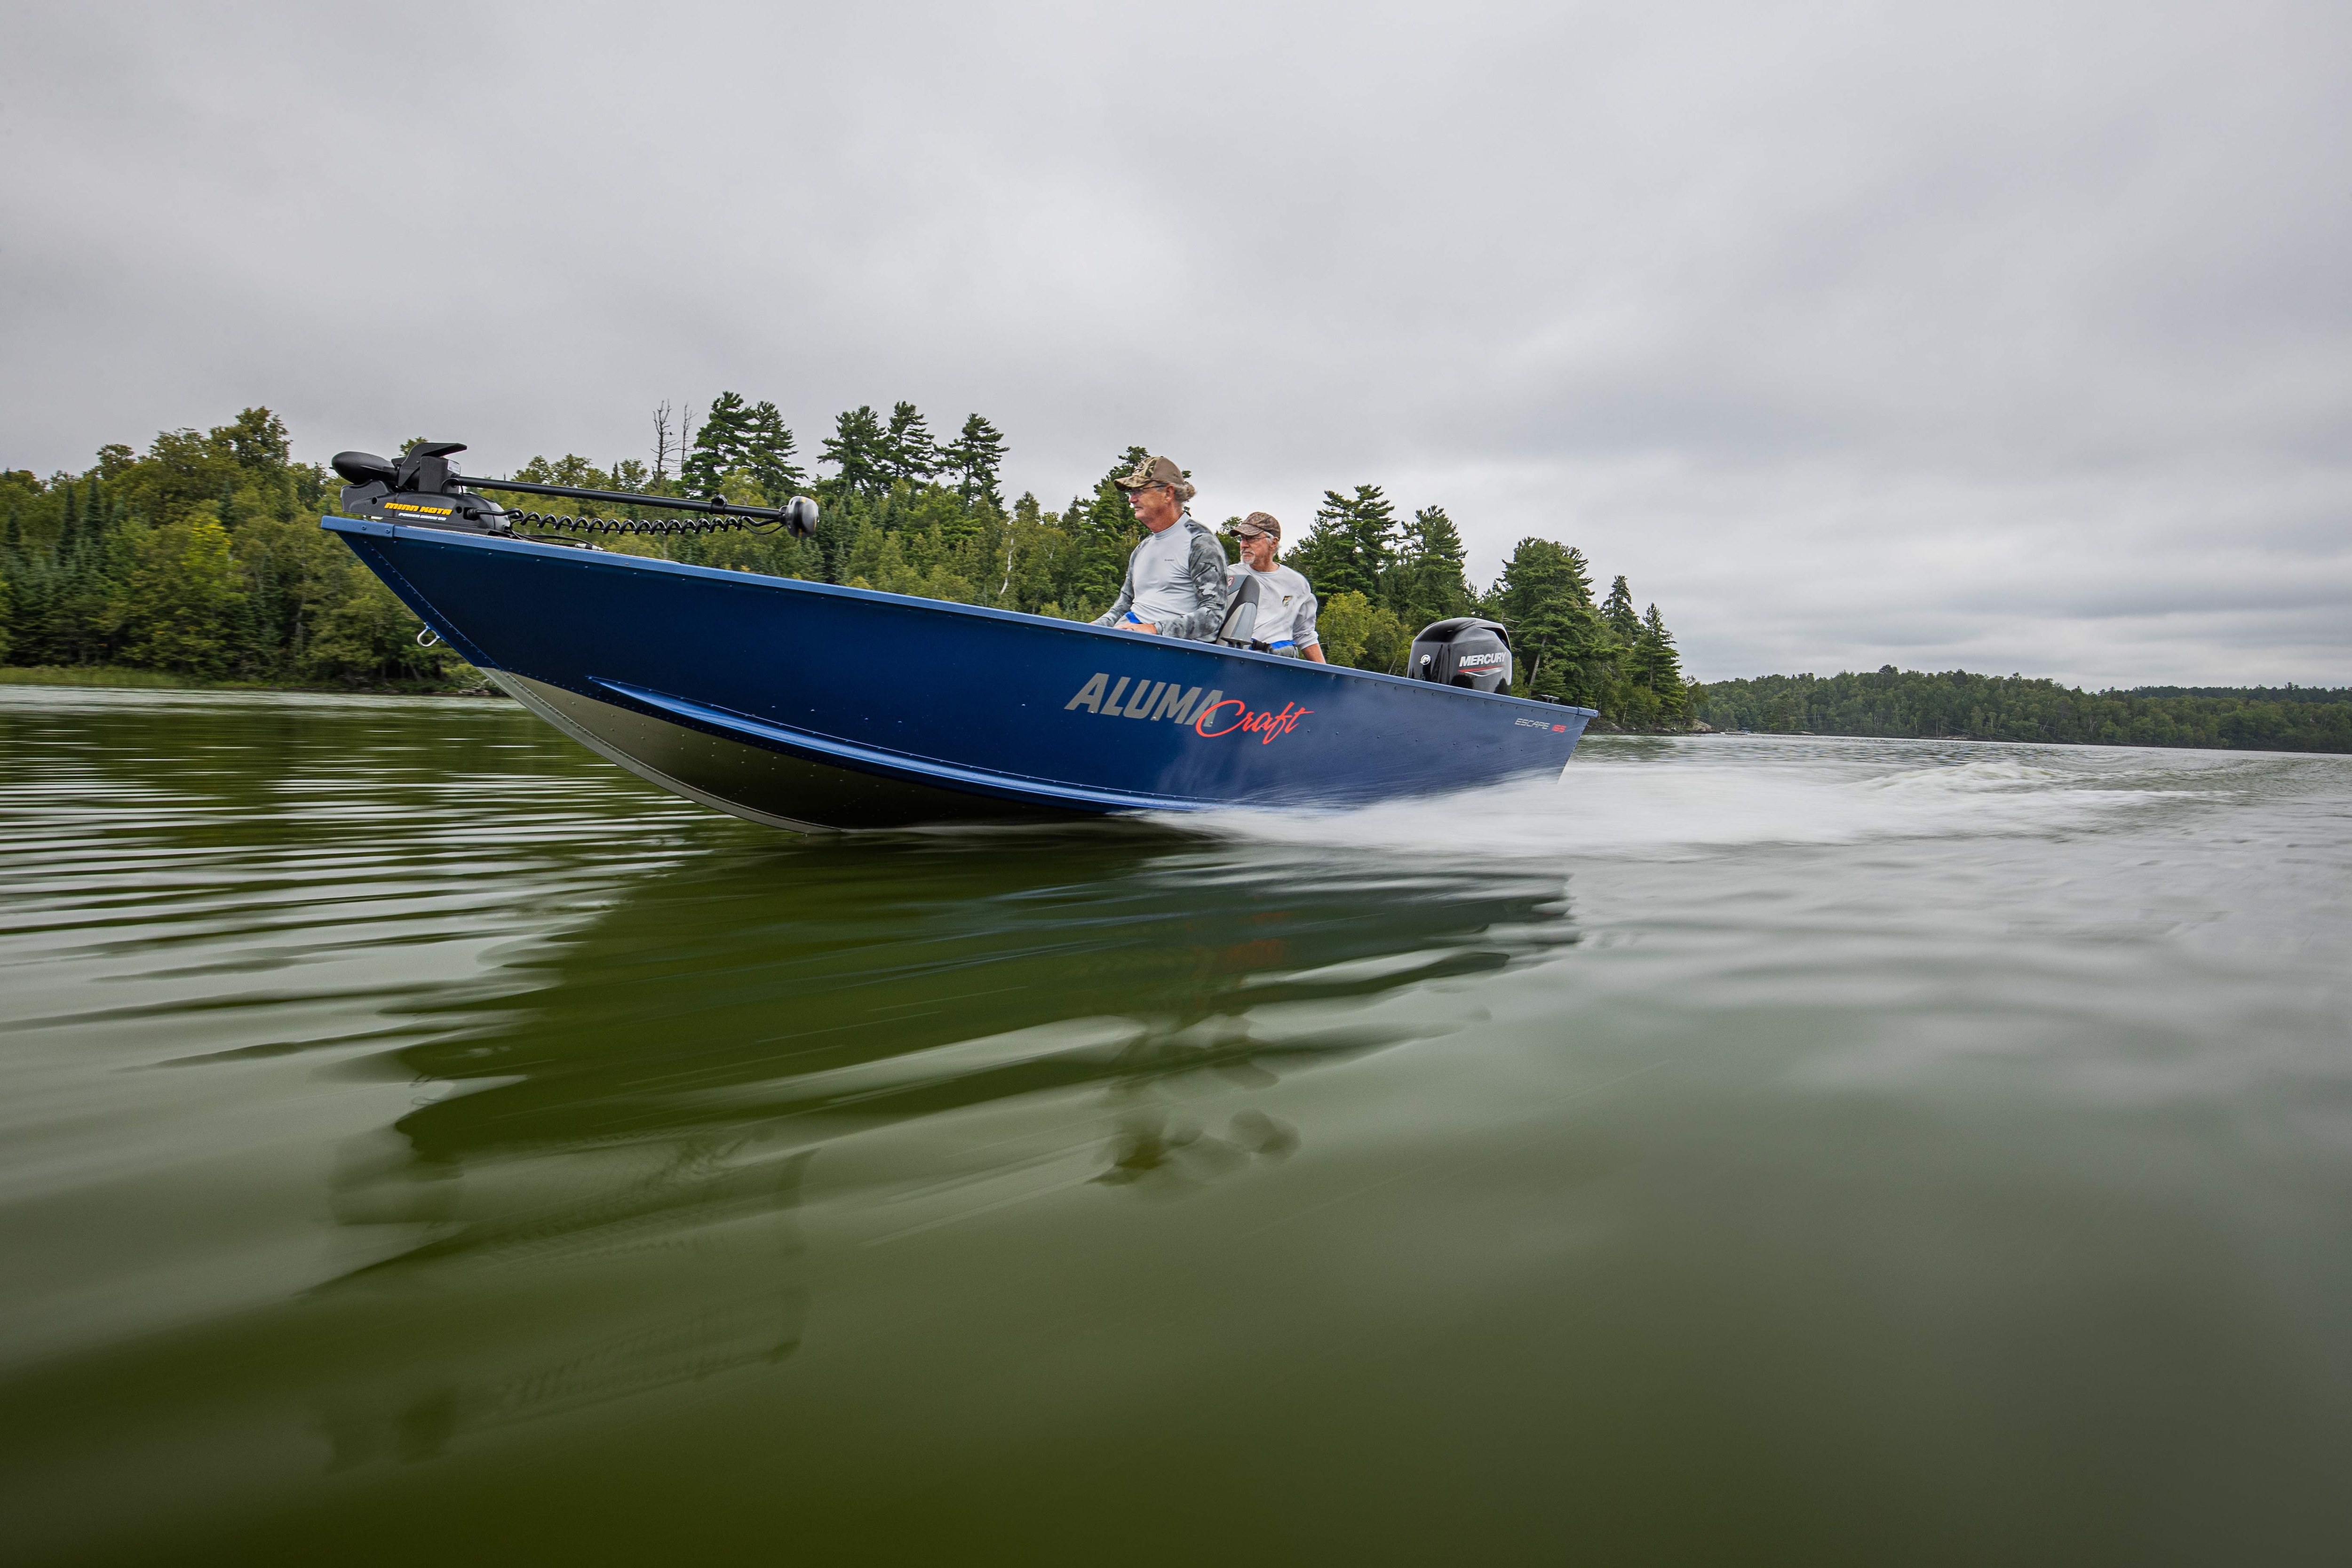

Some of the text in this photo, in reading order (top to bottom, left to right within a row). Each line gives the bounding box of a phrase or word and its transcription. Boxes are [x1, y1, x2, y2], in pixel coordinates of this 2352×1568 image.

[384, 502, 453, 515] MINN KOTA
[1459, 652, 1506, 667] MERCURY
[1515, 718, 1551, 730] ESCAPE
